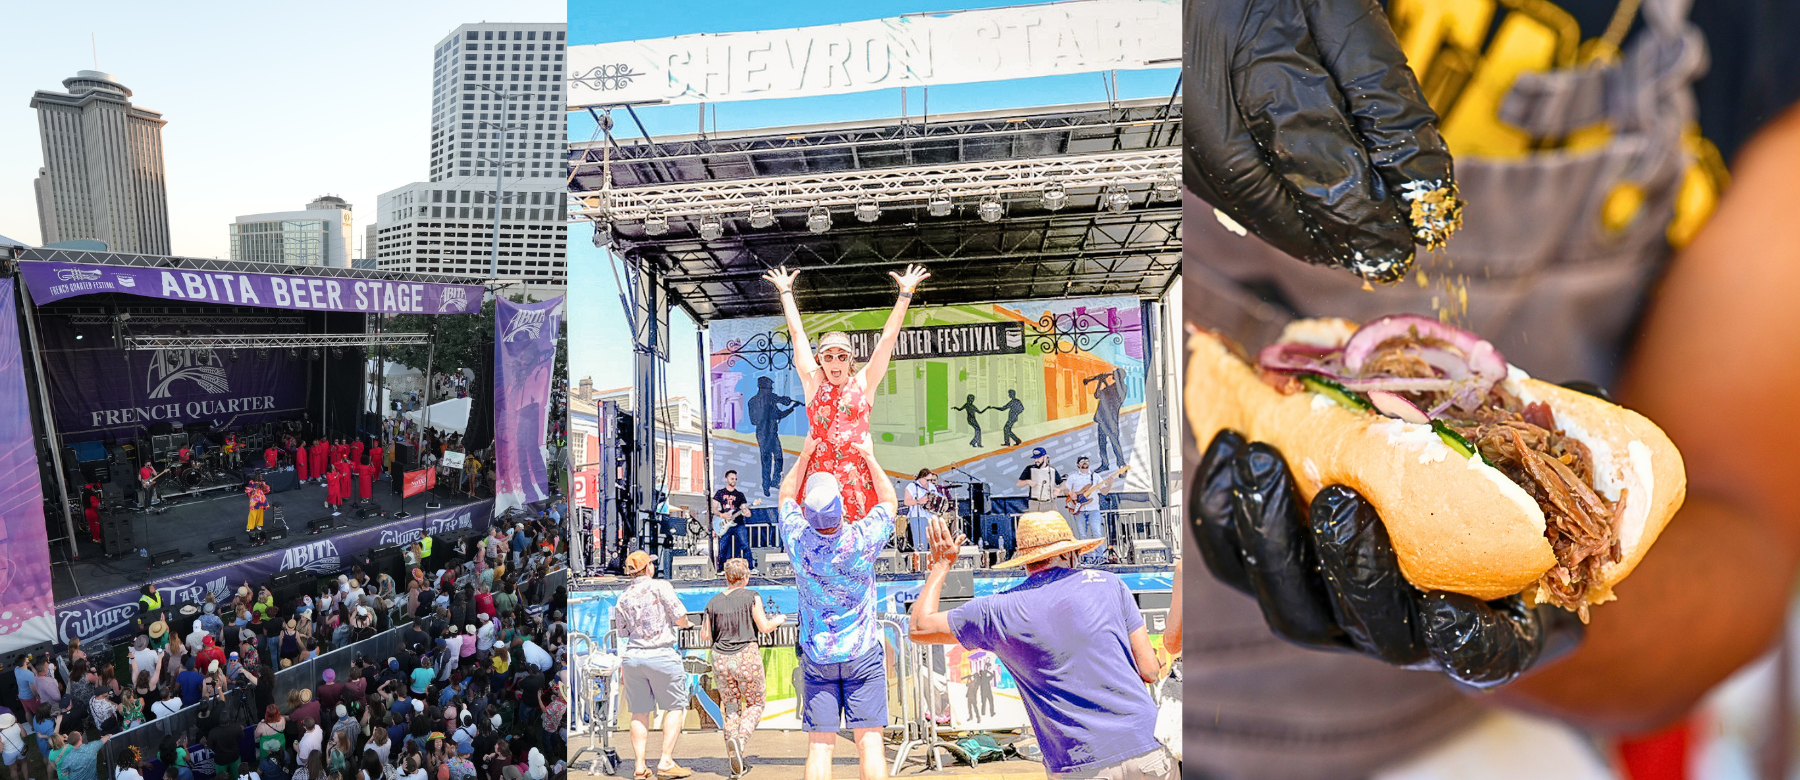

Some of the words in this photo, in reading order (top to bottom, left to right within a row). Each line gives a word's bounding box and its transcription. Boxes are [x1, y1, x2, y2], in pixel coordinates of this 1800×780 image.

[662, 29, 934, 99] CHEVRON
[50, 284, 69, 296] FRENCH
[69, 282, 93, 292] QUARTER
[93, 281, 115, 289] FESTIVAL
[160, 271, 261, 305] ABITA
[270, 276, 344, 310] BEER
[354, 280, 424, 312] STAGE
[438, 286, 467, 310] ABITA
[502, 308, 546, 338] ABITA
[937, 326, 1000, 353] FESTIVAL
[90, 403, 181, 427] FRENCH
[185, 395, 276, 420] QUARTER
[380, 528, 424, 546] Culture
[279, 539, 339, 572] ABITA
[59, 602, 140, 646] Culture
